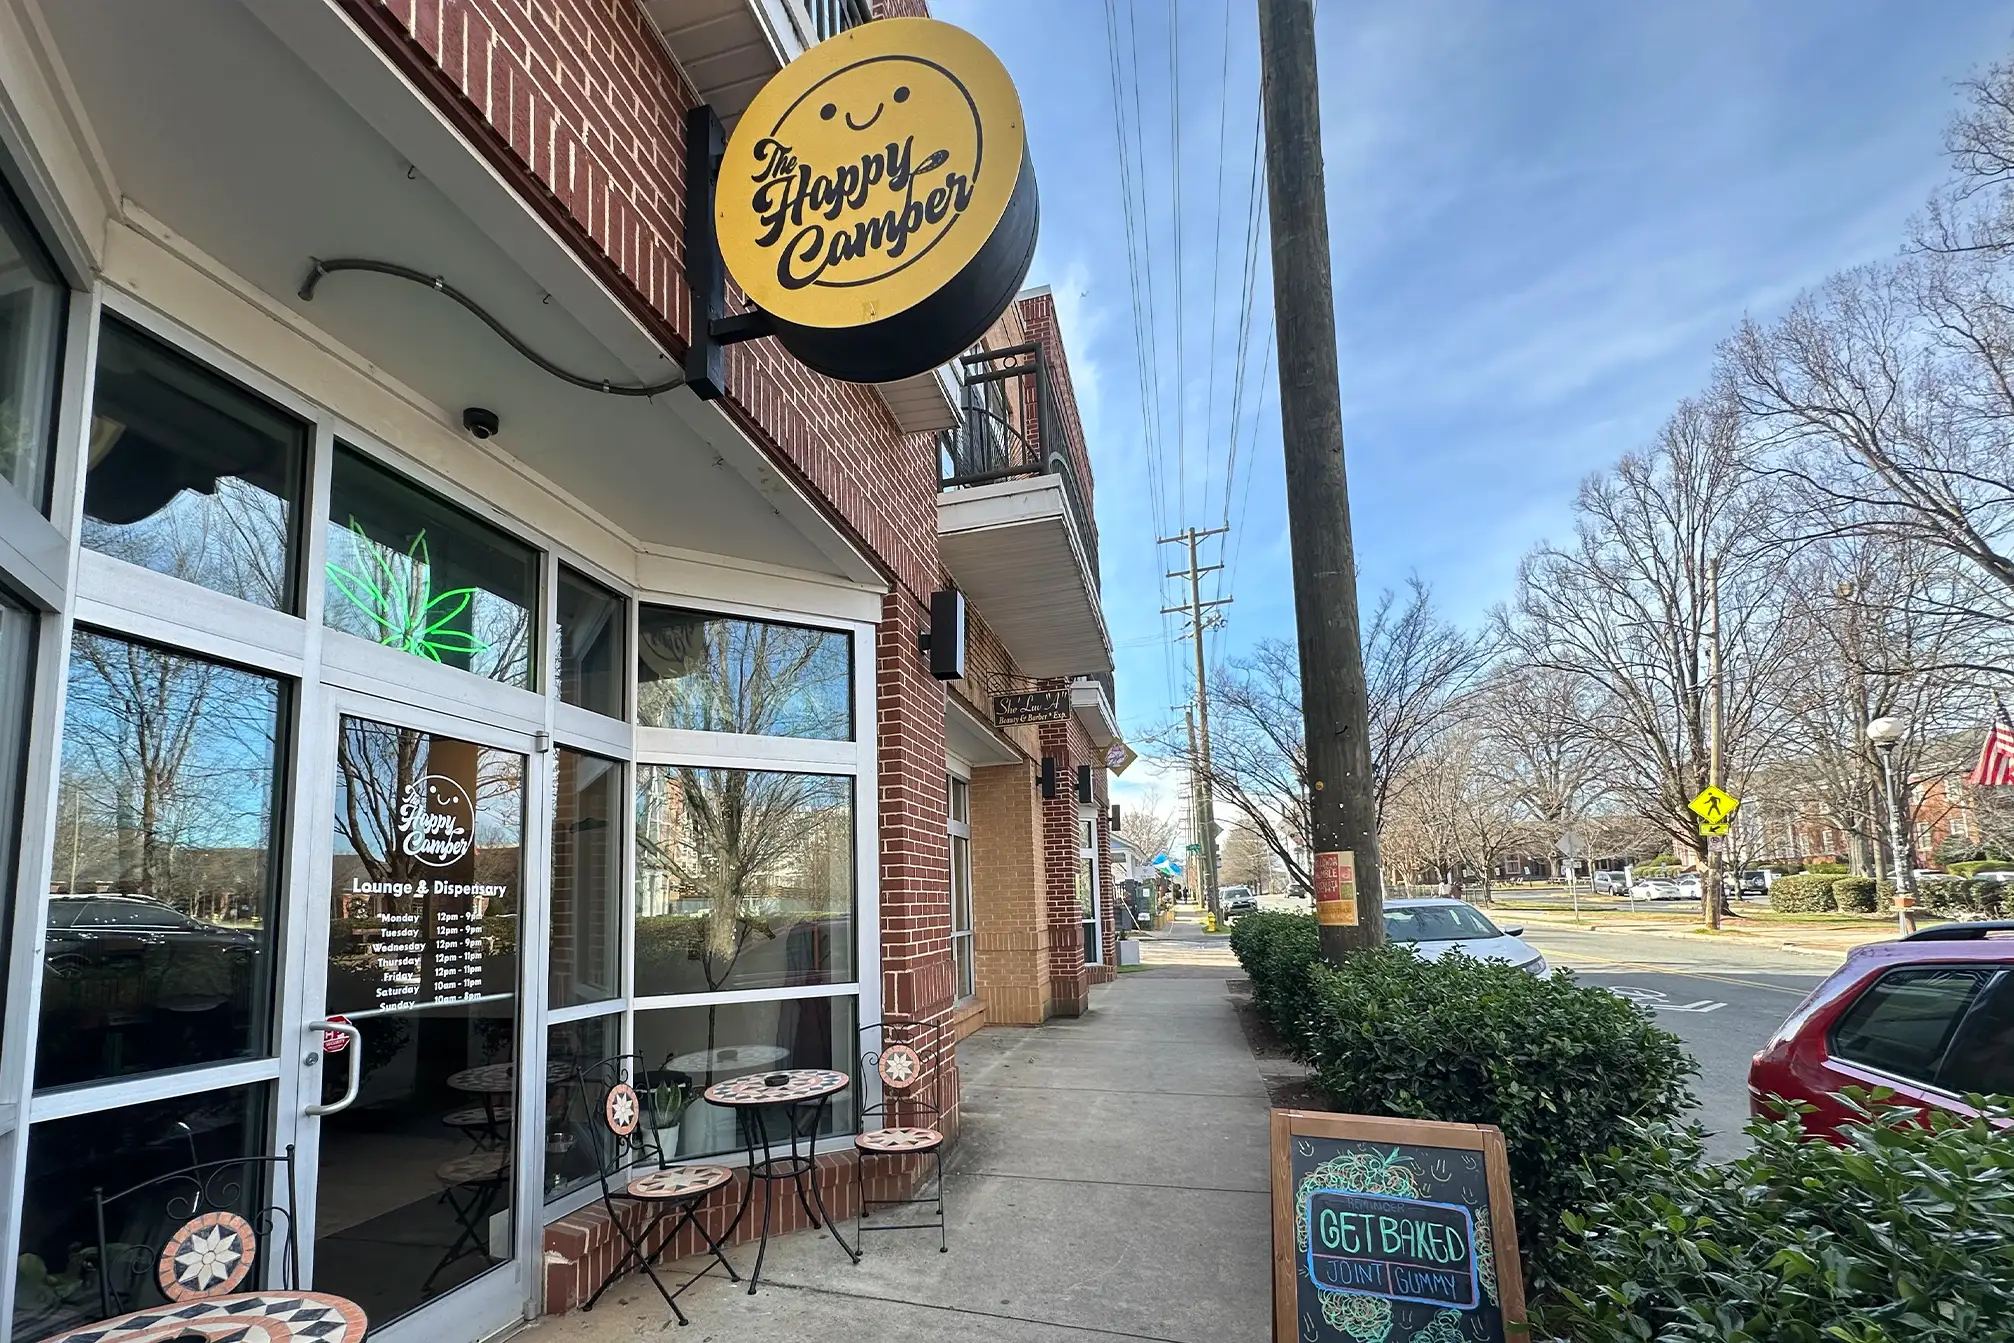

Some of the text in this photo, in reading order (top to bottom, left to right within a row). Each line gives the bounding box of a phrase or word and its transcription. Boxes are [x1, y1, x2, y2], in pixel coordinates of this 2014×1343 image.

[751, 137, 798, 183] The
[751, 135, 915, 248] Happy
[777, 172, 975, 290] Camper
[1020, 714, 1027, 723] &
[1027, 712, 1048, 722] Barber
[397, 803, 457, 836] Happy
[403, 831, 468, 861] Camper
[352, 878, 507, 898] Lounge & Dispensary
[381, 913, 420, 923] Monday
[436, 912, 459, 922] 12pm
[465, 911, 483, 921] 9pm
[380, 928, 420, 938] Tuesday
[436, 926, 459, 936] 12pm
[465, 925, 483, 934] 9pm
[372, 942, 427, 953] Wednesday
[435, 940, 458, 950] 12pm
[464, 938, 482, 948] 9pm
[377, 957, 421, 968] Thursday
[435, 953, 457, 963] 12pm
[463, 951, 482, 962] 11pm
[383, 972, 414, 982] Friday
[434, 967, 457, 977] 12pm
[463, 964, 482, 974] 11pm
[375, 985, 420, 998] Saturday
[434, 981, 456, 991] 10am
[463, 978, 482, 988] 11pm
[379, 1000, 416, 1012] Sunday
[1319, 1208, 1466, 1264] GET BAKED
[1326, 1259, 1383, 1286] JOINT
[1394, 1266, 1457, 1300] GUMMY
